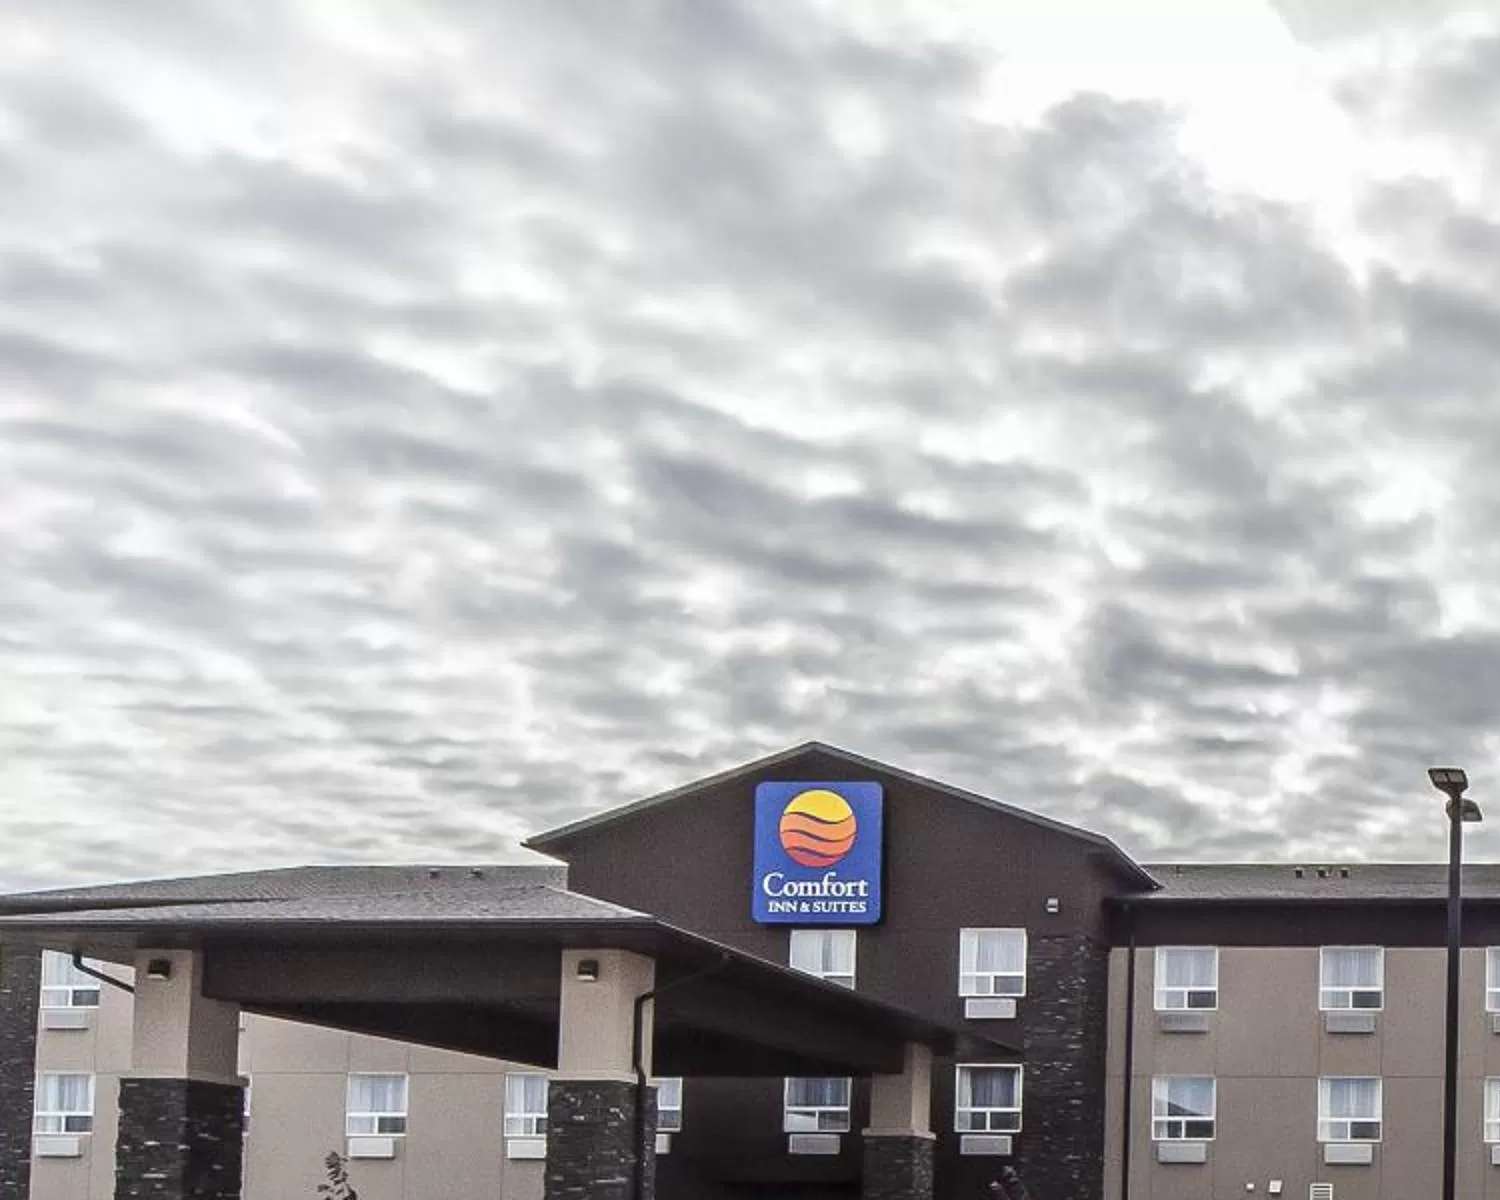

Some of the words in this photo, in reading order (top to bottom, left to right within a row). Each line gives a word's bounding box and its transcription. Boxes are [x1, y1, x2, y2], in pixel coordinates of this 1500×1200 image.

[763, 872, 869, 897] Comfort
[768, 901, 798, 913] INN
[800, 901, 811, 913] &
[812, 901, 867, 913] SUITES
